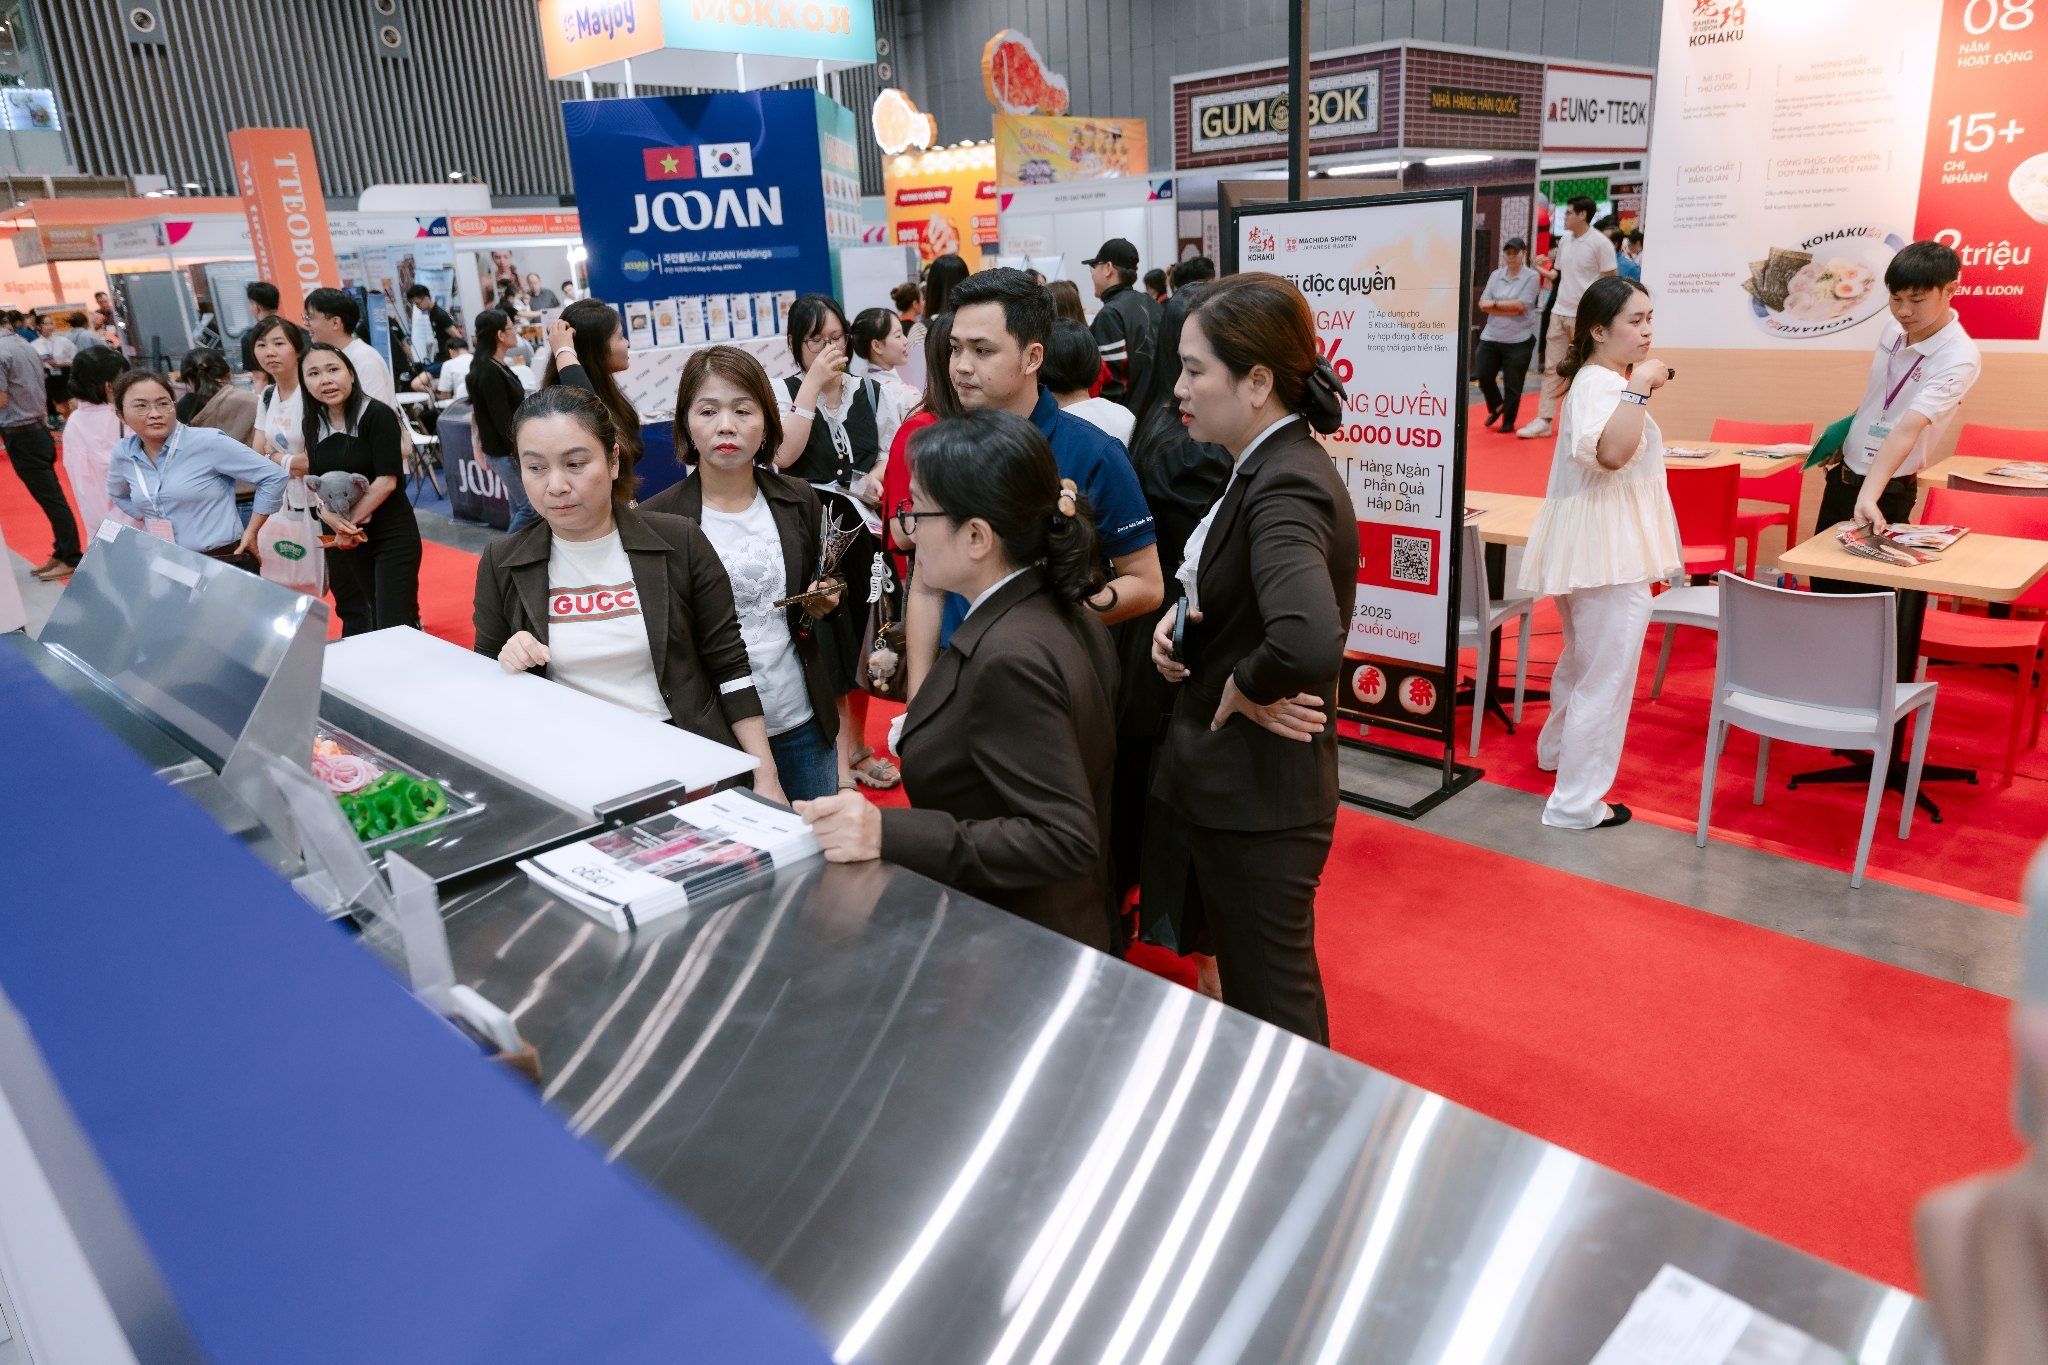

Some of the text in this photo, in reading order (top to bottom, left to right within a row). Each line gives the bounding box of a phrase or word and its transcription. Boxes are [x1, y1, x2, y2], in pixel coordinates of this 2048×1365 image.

[1963, 0, 2034, 35] 08
[1689, 30, 1744, 47] KOHAKU
[1959, 40, 1990, 54] NĂM
[1957, 50, 2033, 68] HOẠT ĐỘNG
[1202, 100, 1266, 138] GUM
[1948, 112, 2025, 154] 15+
[1943, 160, 1966, 172] CHI
[1942, 171, 1988, 185] NHÁNH
[1330, 235, 1357, 243] SHOTEN
[1801, 227, 1868, 250] KOHAKU
[1247, 253, 1275, 261] KOHAKU
[1961, 240, 2031, 271] triệu
[1303, 273, 1335, 297] độc
[1338, 265, 1396, 296] quyền
[1972, 285, 1983, 296] &
[1986, 285, 2024, 296] UDON
[1406, 310, 1420, 318] cho
[1368, 321, 1373, 329] 5
[1411, 332, 1416, 340] &
[1367, 344, 1385, 353] trong
[1400, 344, 1416, 353] gian
[1374, 383, 1447, 418] QUYỀN
[1396, 427, 1442, 448] USD
[1360, 460, 1430, 479] Hàng Ngàn
[1364, 475, 1425, 496] Phần Quà
[1367, 493, 1420, 513] Hấp Dẫn
[1360, 604, 1392, 620] 2025
[1357, 619, 1383, 635] cuối
[1386, 626, 1421, 645] cùng!
